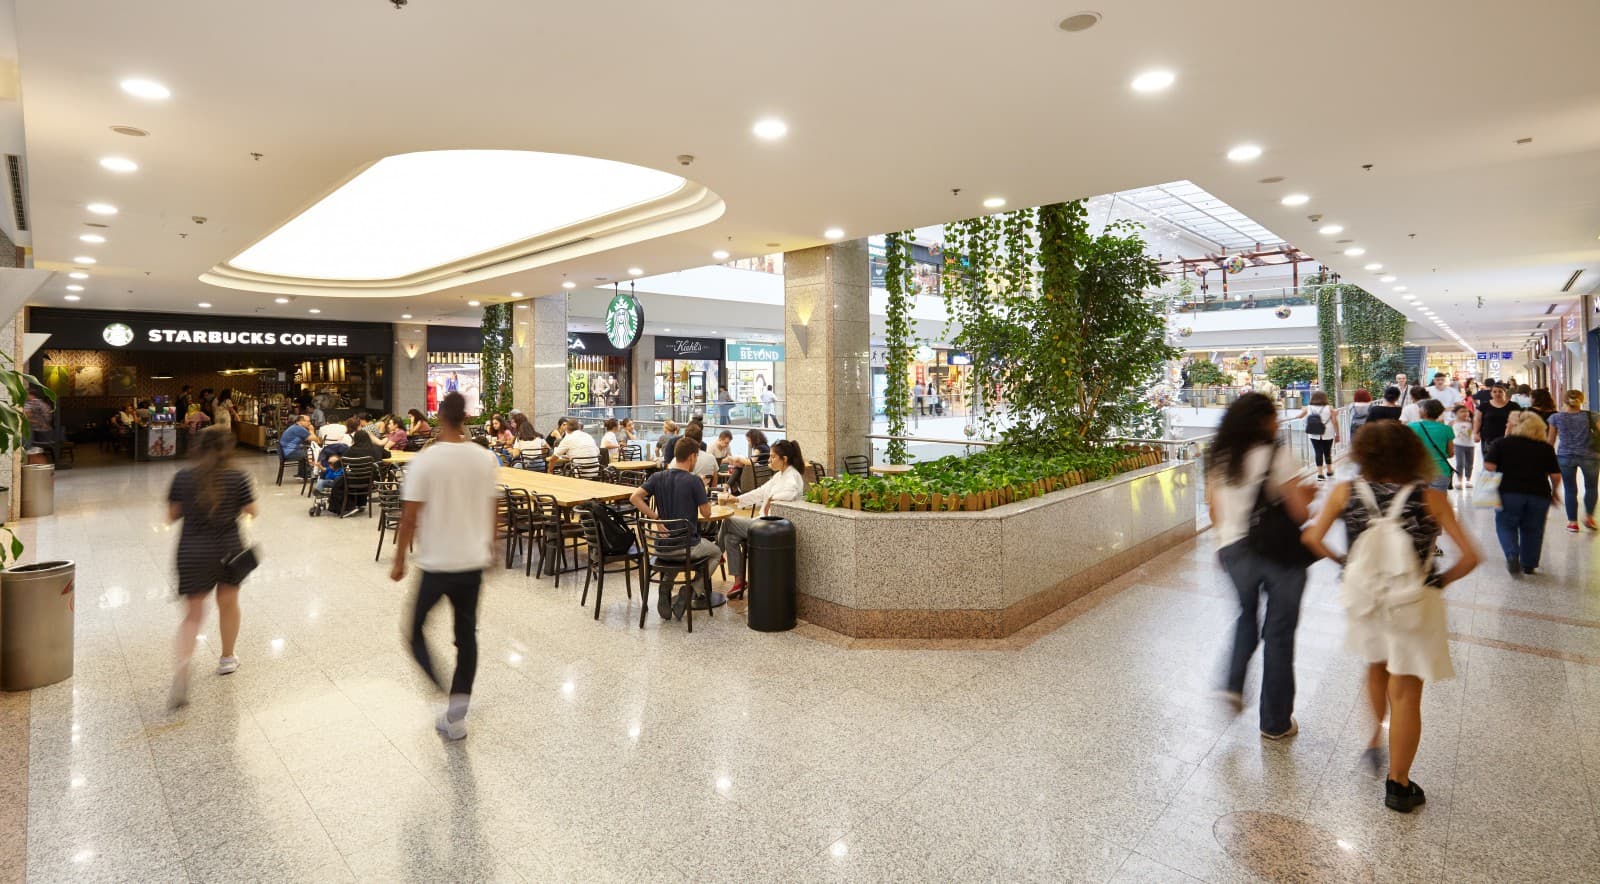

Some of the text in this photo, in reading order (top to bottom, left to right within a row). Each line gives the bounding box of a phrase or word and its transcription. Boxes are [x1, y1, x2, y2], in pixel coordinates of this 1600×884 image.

[148, 329, 348, 346] STARBUCKS COFFEE
[673, 340, 702, 355] Kiehl's
[740, 349, 779, 360] BEYOND
[573, 392, 586, 403] 70
